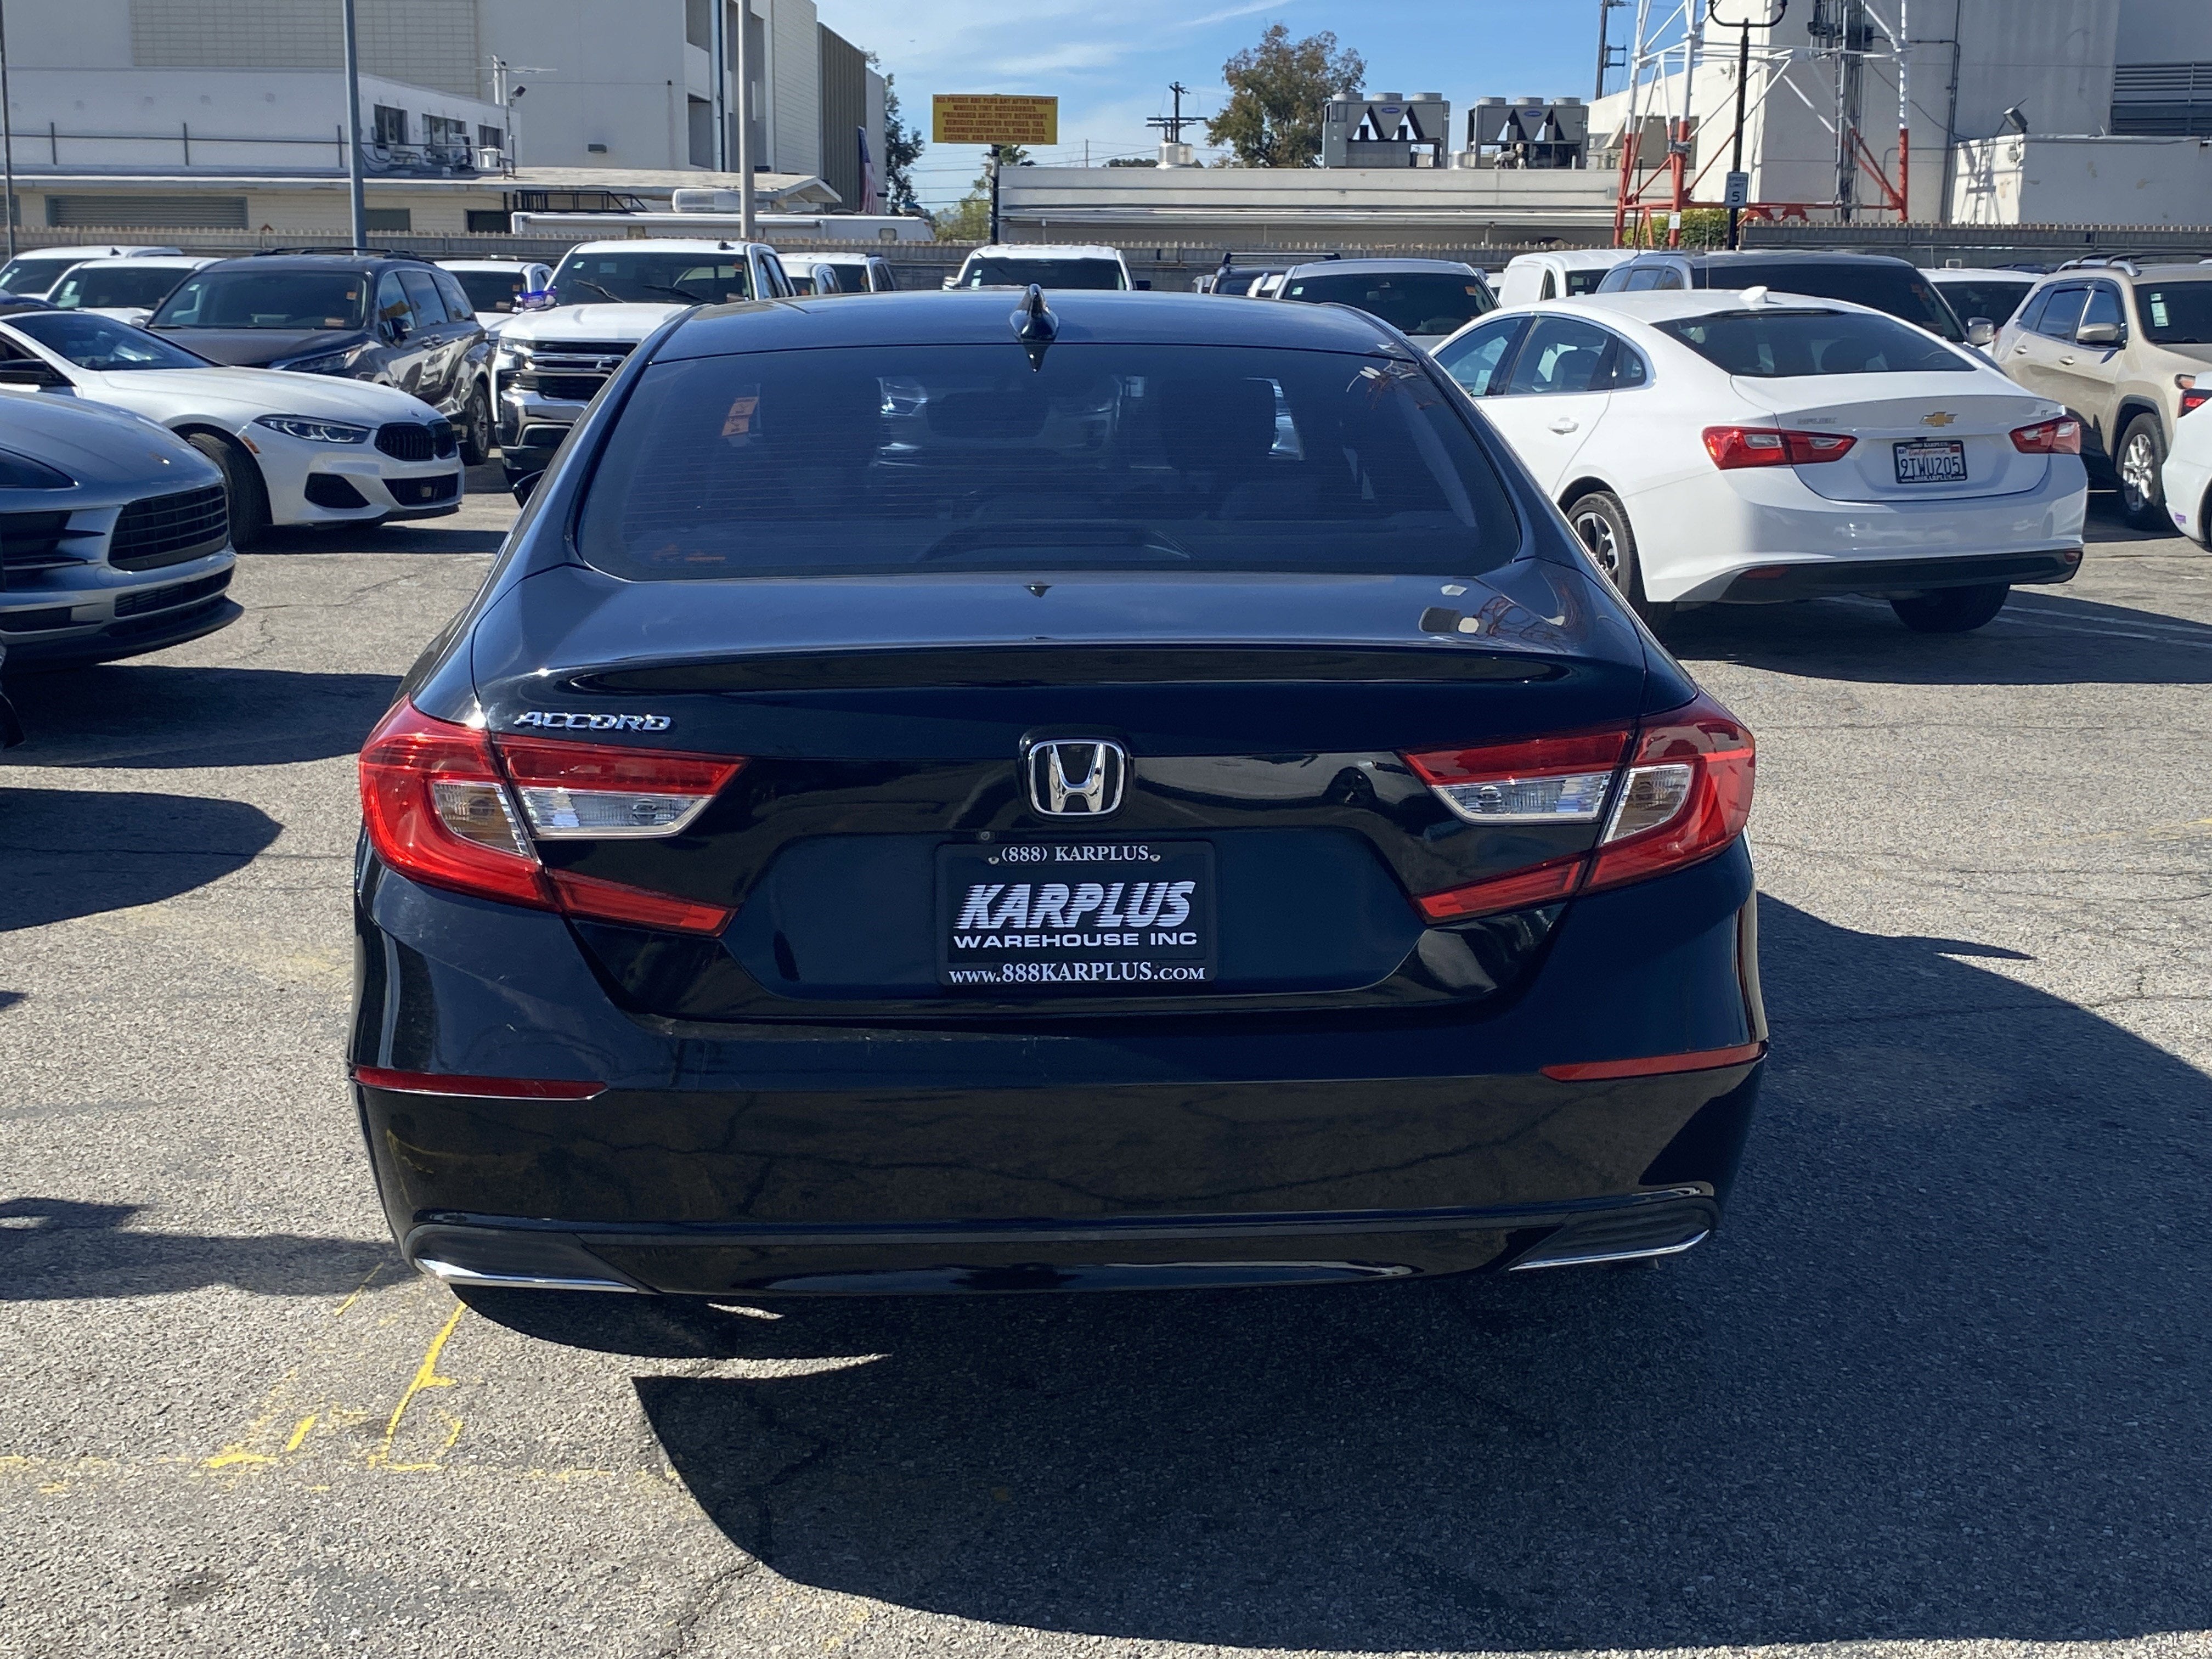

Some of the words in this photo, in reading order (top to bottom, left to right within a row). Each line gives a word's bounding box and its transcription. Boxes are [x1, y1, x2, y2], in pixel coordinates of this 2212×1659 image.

[1731, 191, 1740, 202] 5
[1900, 456, 1960, 478] 9TWU205
[513, 711, 672, 731] ACCORD
[1001, 846, 1047, 862] (888)
[1054, 845, 1149, 861] KARPLUS
[953, 881, 1196, 929] KARPLUS
[953, 933, 1139, 949] WAREHOUSE
[1150, 932, 1198, 945] INC
